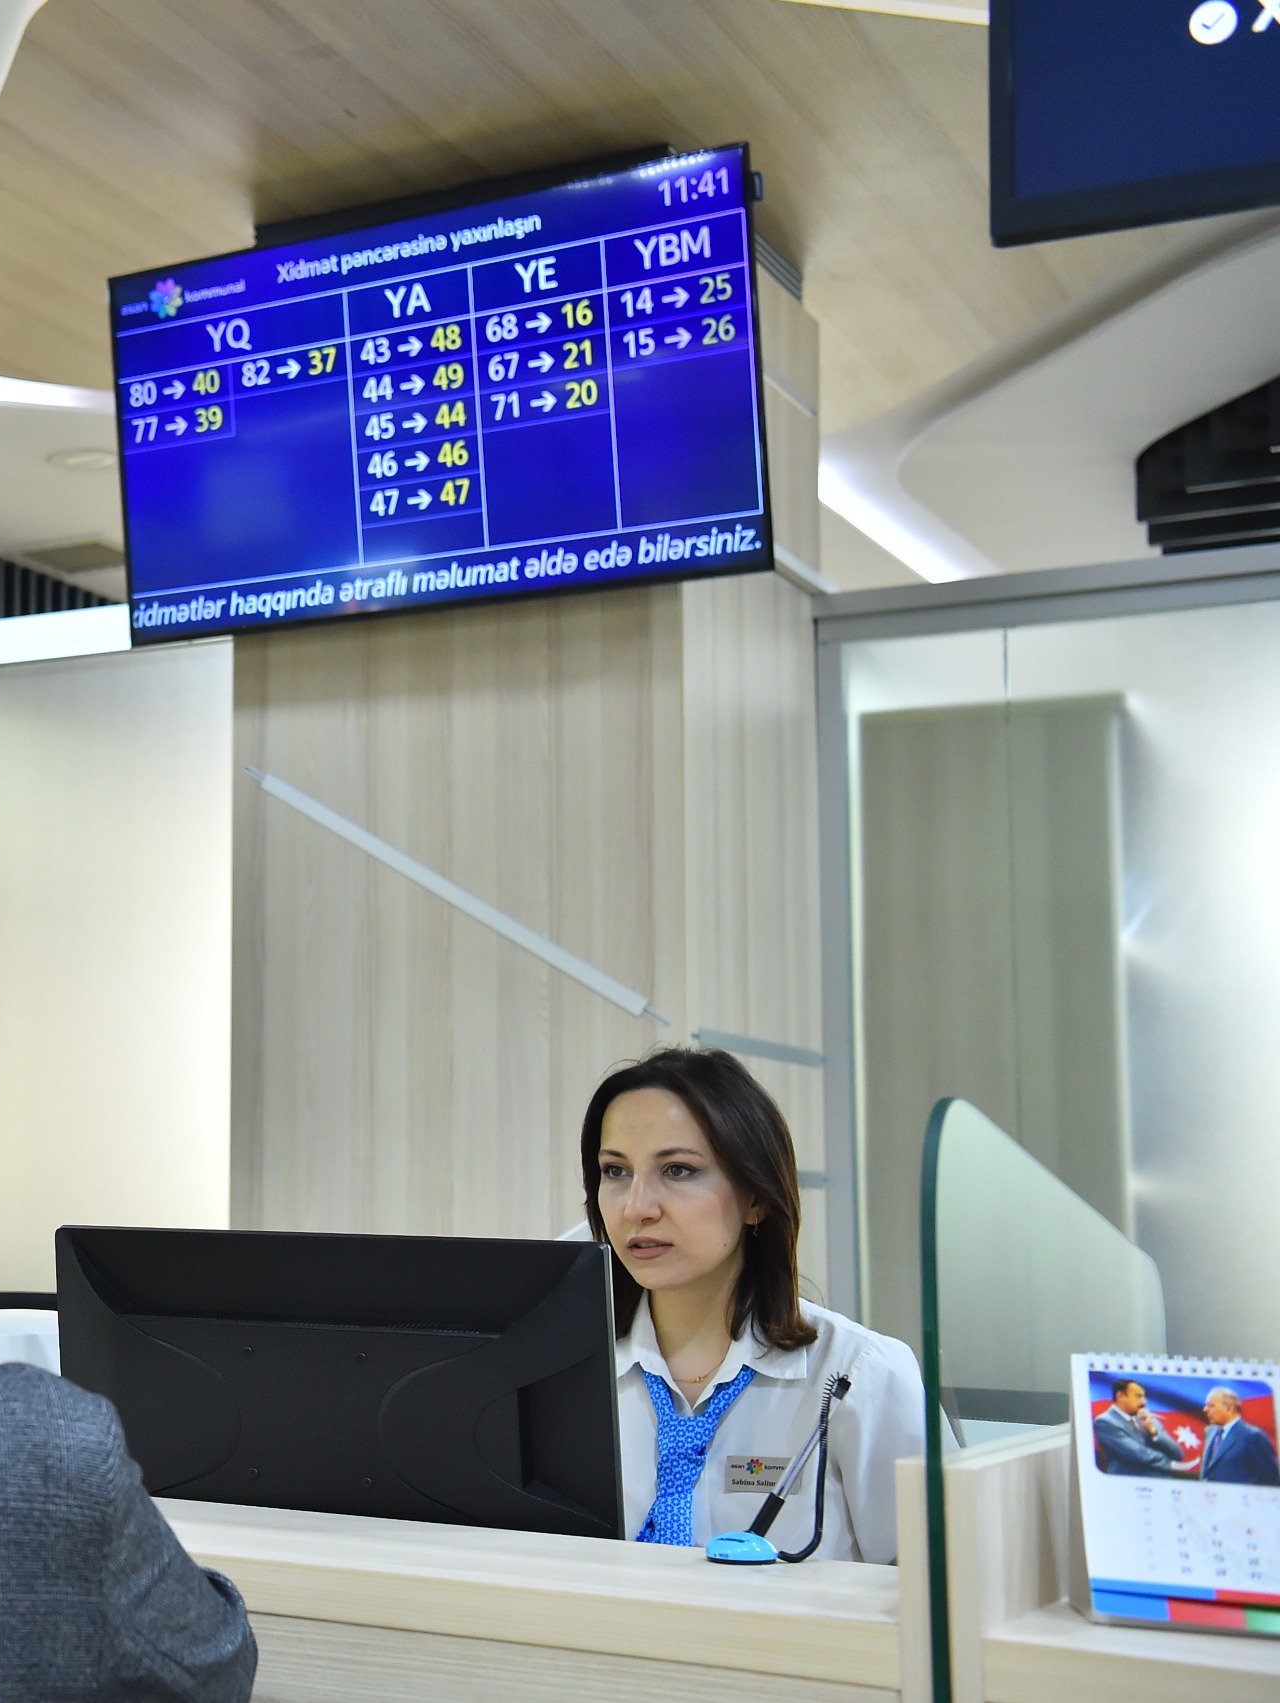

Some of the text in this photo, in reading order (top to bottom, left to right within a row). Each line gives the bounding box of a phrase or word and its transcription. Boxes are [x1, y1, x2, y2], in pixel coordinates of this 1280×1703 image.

[657, 166, 729, 207] 11:41
[276, 214, 542, 284] Xidmət pəncərəsinə yaxınlaşın
[633, 225, 712, 270] YBM
[184, 278, 246, 303] kommunal
[515, 257, 559, 293] YE
[620, 272, 733, 318] 14 25
[384, 283, 432, 318] YA
[485, 299, 594, 343] 68 16
[206, 318, 253, 352] YQ
[360, 324, 462, 365] 43 48
[622, 314, 736, 359] 15 26
[241, 346, 337, 387] 82 37
[487, 339, 593, 382] 67 21
[129, 369, 220, 407] 80 40
[362, 362, 465, 403] 44 49
[490, 378, 598, 421] 71 20
[131, 405, 223, 444] 77 39
[365, 401, 467, 441] 45 44
[367, 439, 469, 479] 46 46
[369, 477, 471, 517] 47 47
[229, 579, 335, 619] haqqında
[338, 569, 409, 603] ətraflı
[412, 556, 522, 594] məlumat
[524, 546, 579, 579] əldə
[583, 540, 633, 571] edə
[637, 523, 762, 565] bilərsiniz.
